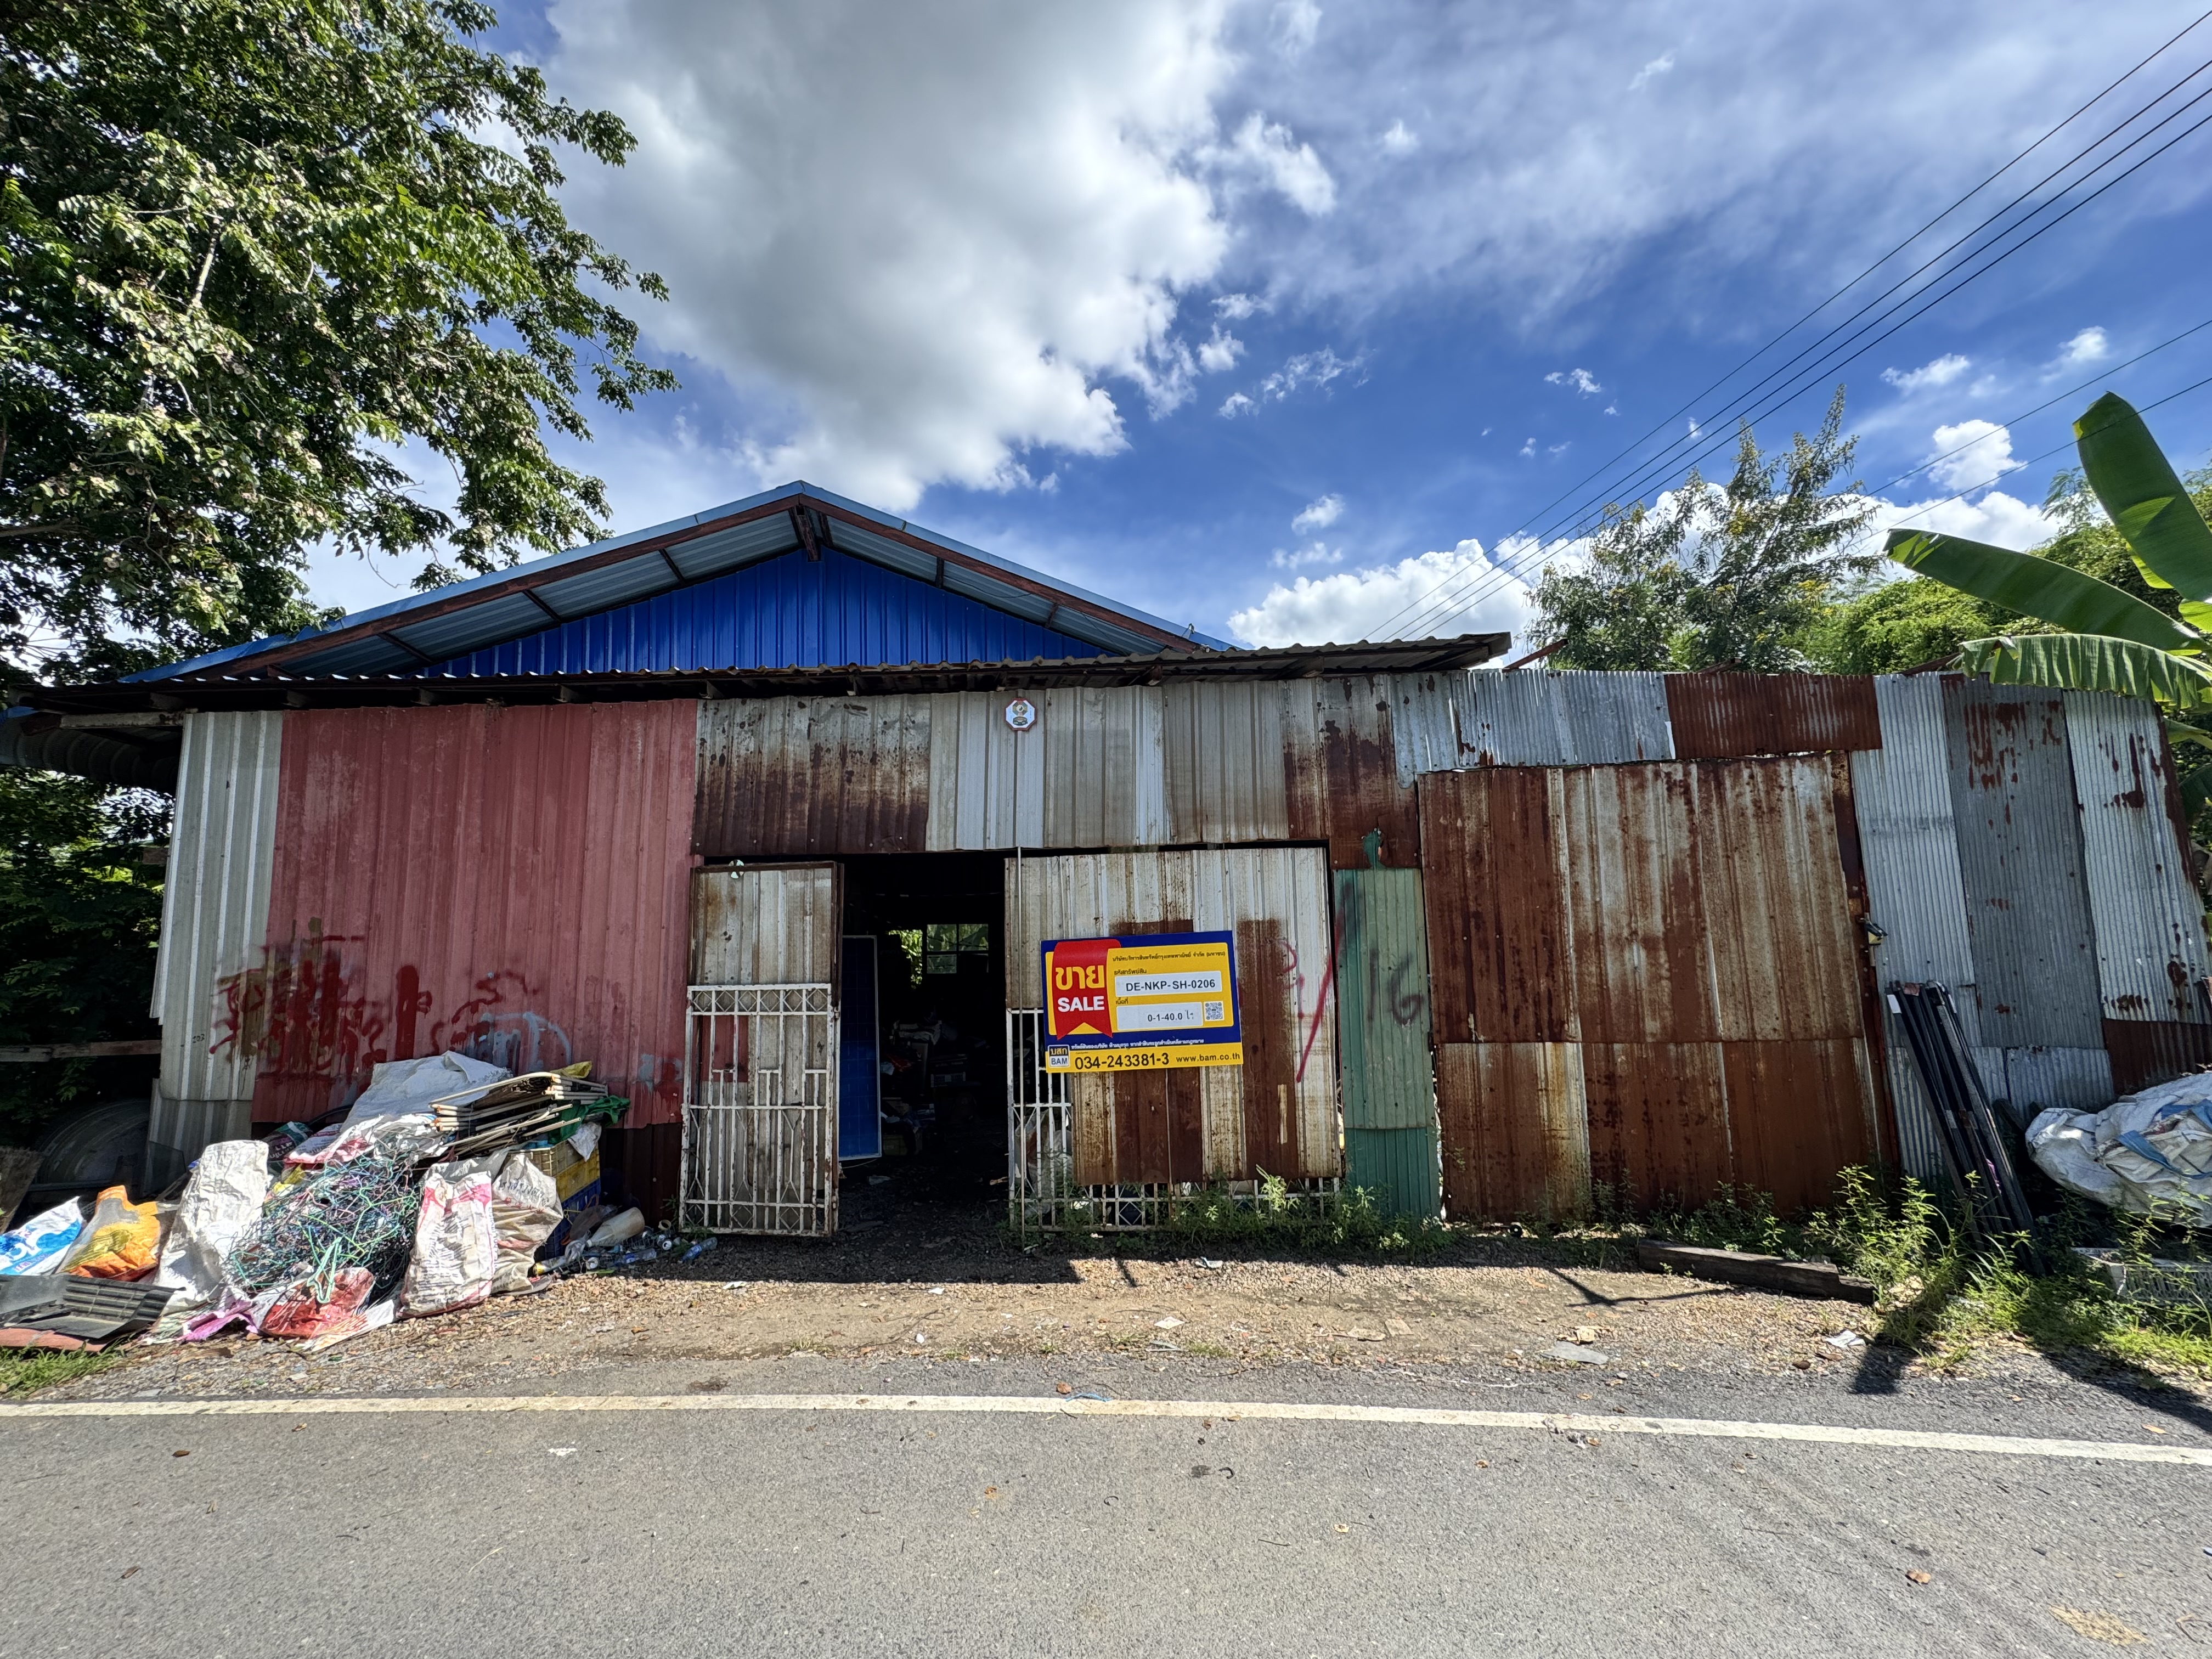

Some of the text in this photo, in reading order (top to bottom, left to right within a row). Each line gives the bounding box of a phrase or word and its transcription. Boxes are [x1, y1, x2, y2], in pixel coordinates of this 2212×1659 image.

[1055, 965, 1105, 990] ขาย
[1057, 995, 1105, 1013] SALE
[1147, 1012, 1183, 1022] 0-1-40.0
[1075, 1052, 1169, 1070] 034-243381-3
[1176, 1052, 1240, 1063] www.bam.co.th
